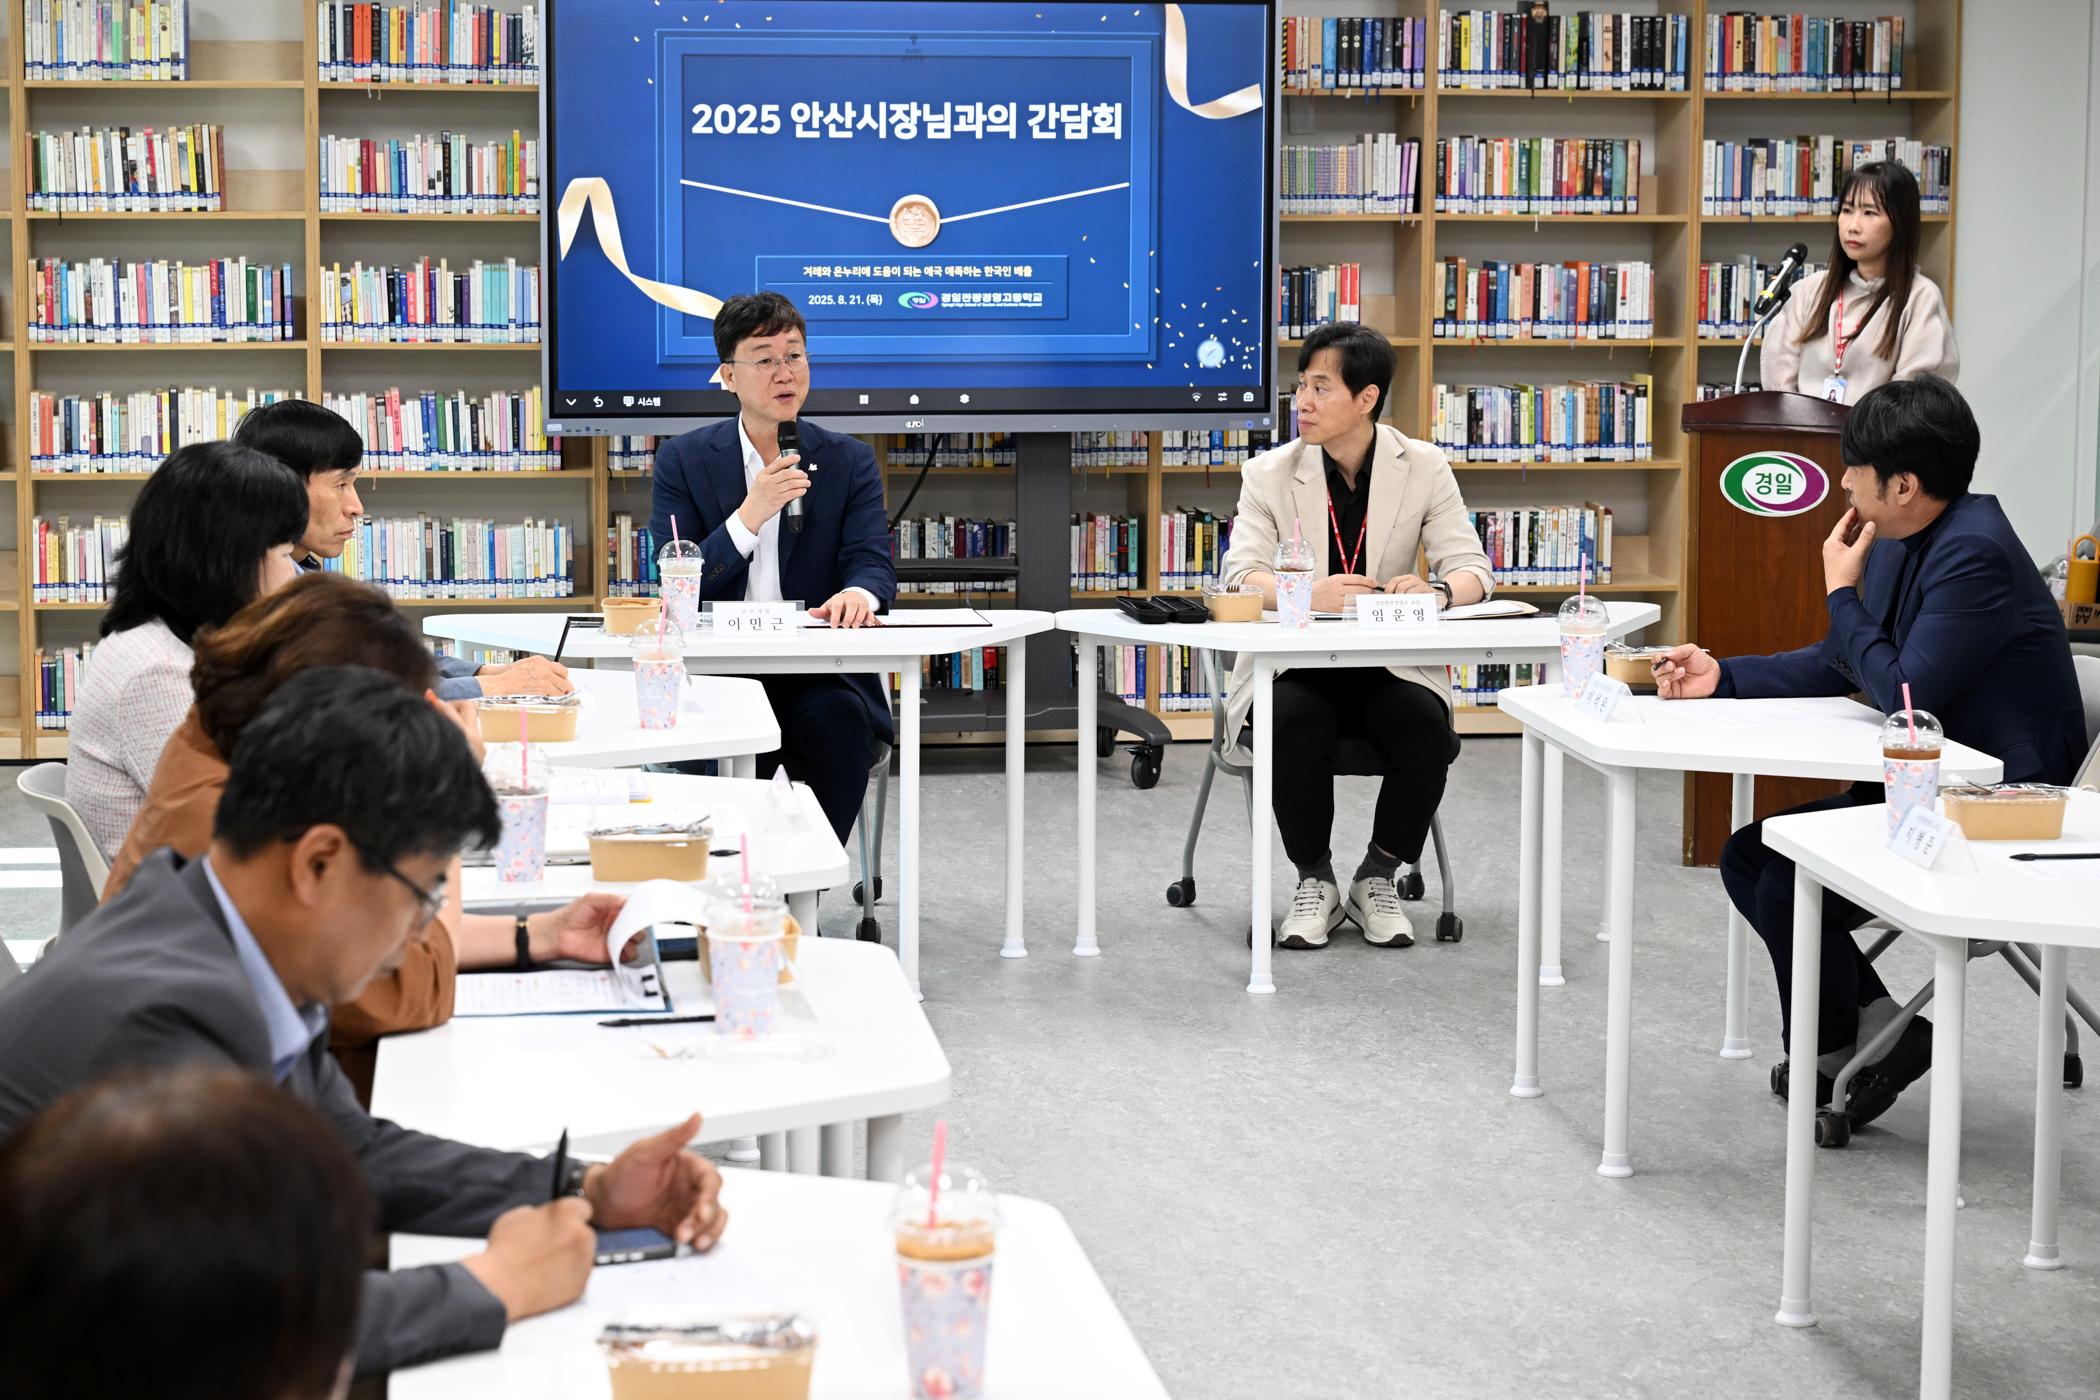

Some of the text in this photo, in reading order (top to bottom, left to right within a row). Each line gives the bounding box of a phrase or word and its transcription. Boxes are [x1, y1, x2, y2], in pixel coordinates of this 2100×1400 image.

[691, 101, 1122, 140] 2025 안산시장님과의 간담회
[803, 266, 1033, 277] 겨레와 온누리에 도움이 되는 애국 애족하는 한국인 배출
[808, 294, 883, 306] 2025. 8. 21. (목)
[941, 292, 1042, 303] 경일관광경영고등학교
[1755, 472, 1792, 495] 경일
[1371, 608, 1425, 622] 임운영
[2075, 612, 2092, 625] A4
[728, 617, 784, 631] 이민근
